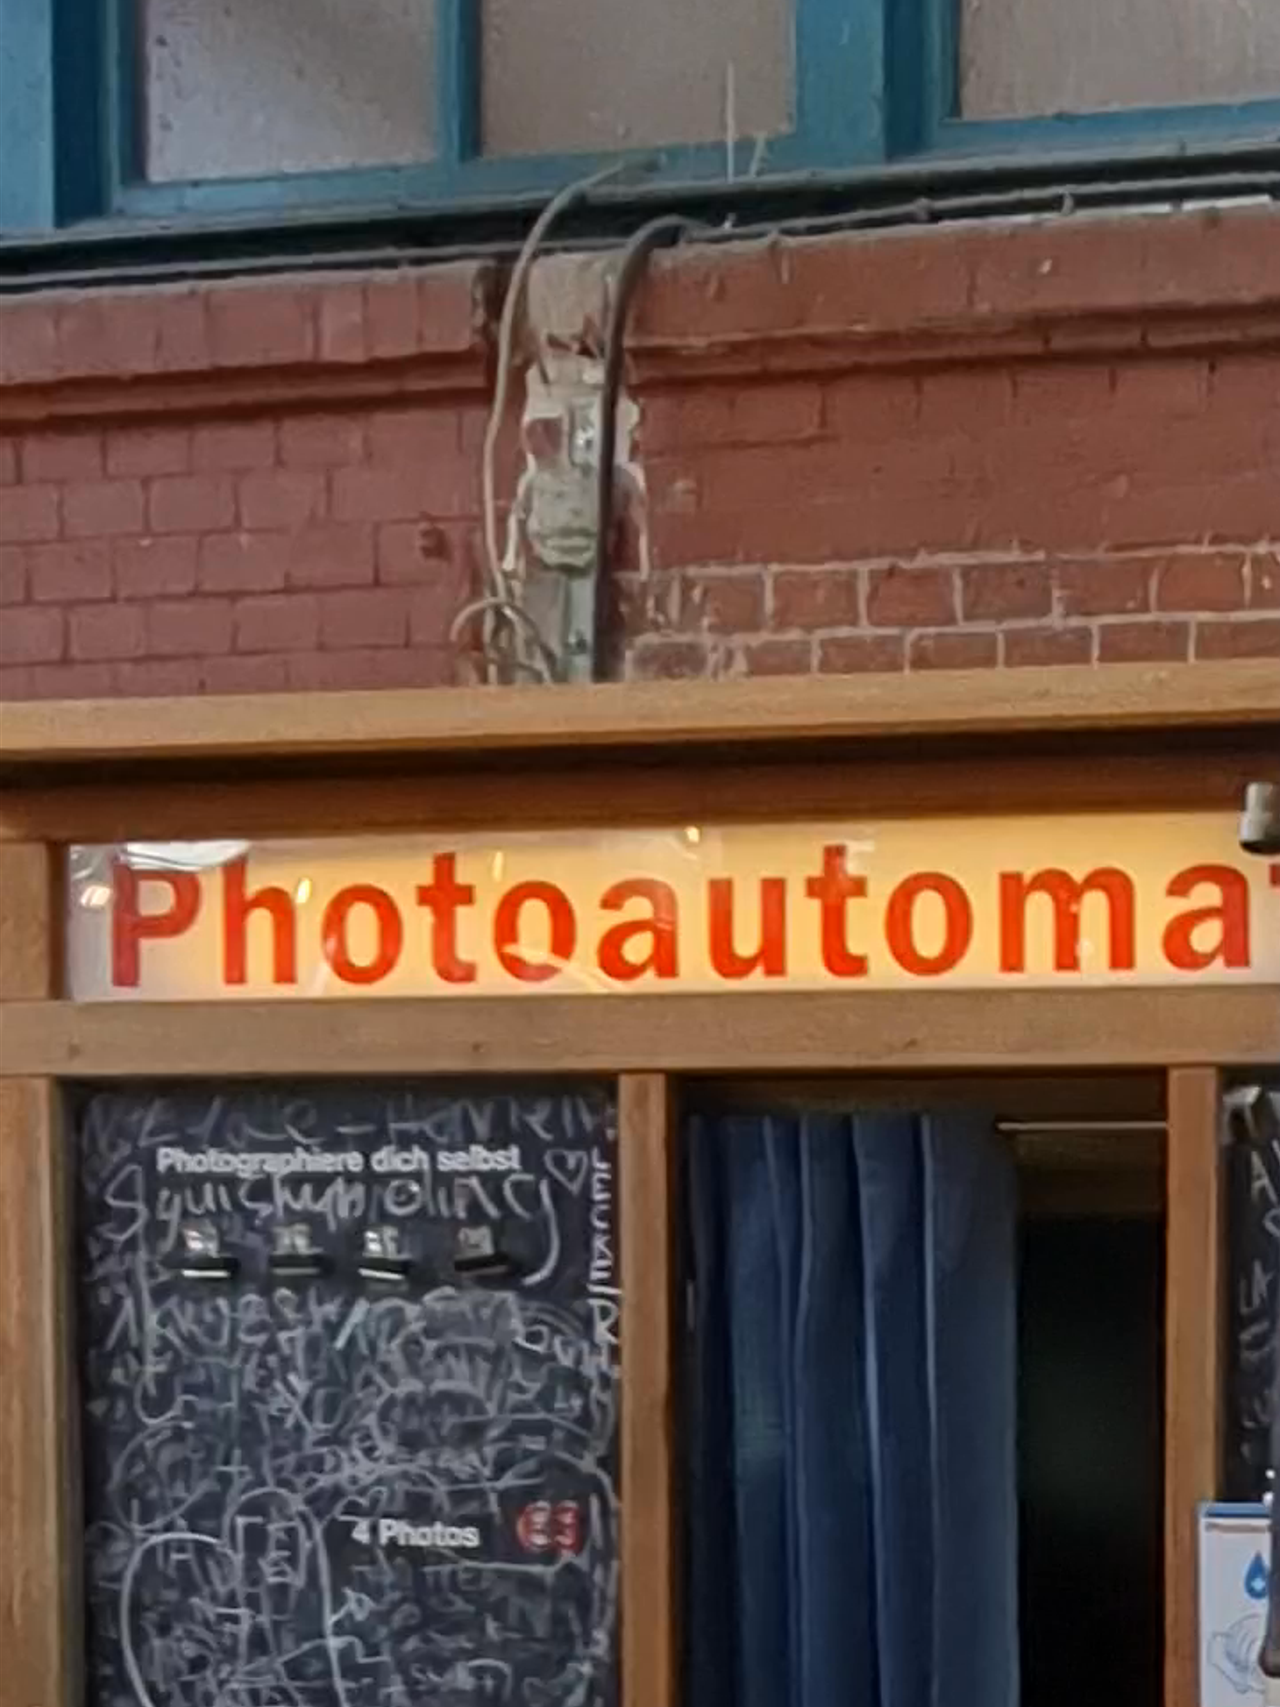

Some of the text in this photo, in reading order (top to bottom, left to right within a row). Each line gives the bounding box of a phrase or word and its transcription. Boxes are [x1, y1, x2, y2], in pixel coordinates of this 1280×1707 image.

[370, 1145, 431, 1174] dich
[436, 1145, 522, 1174] selbst
[378, 1520, 480, 1550] Photos
